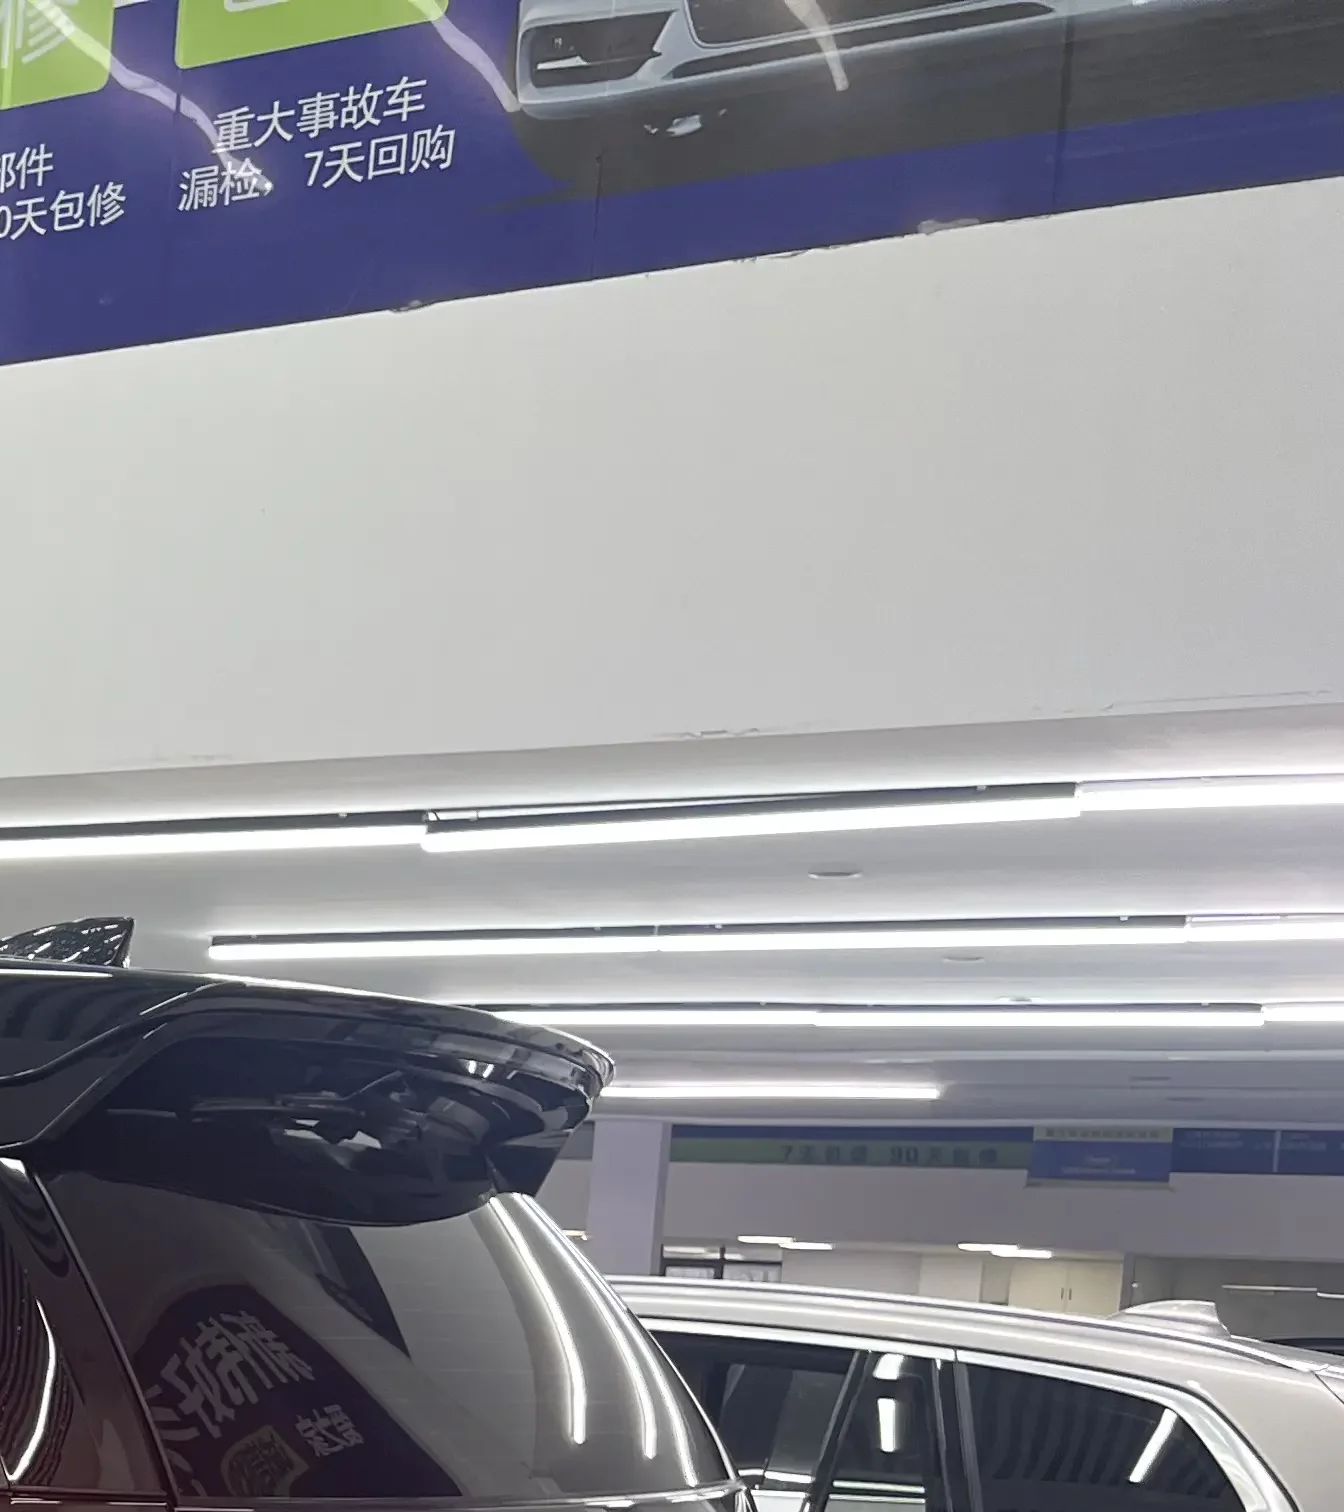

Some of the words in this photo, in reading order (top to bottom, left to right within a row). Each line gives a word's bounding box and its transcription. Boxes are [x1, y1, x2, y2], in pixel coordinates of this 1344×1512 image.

[212, 76, 427, 154] 重大事故车
